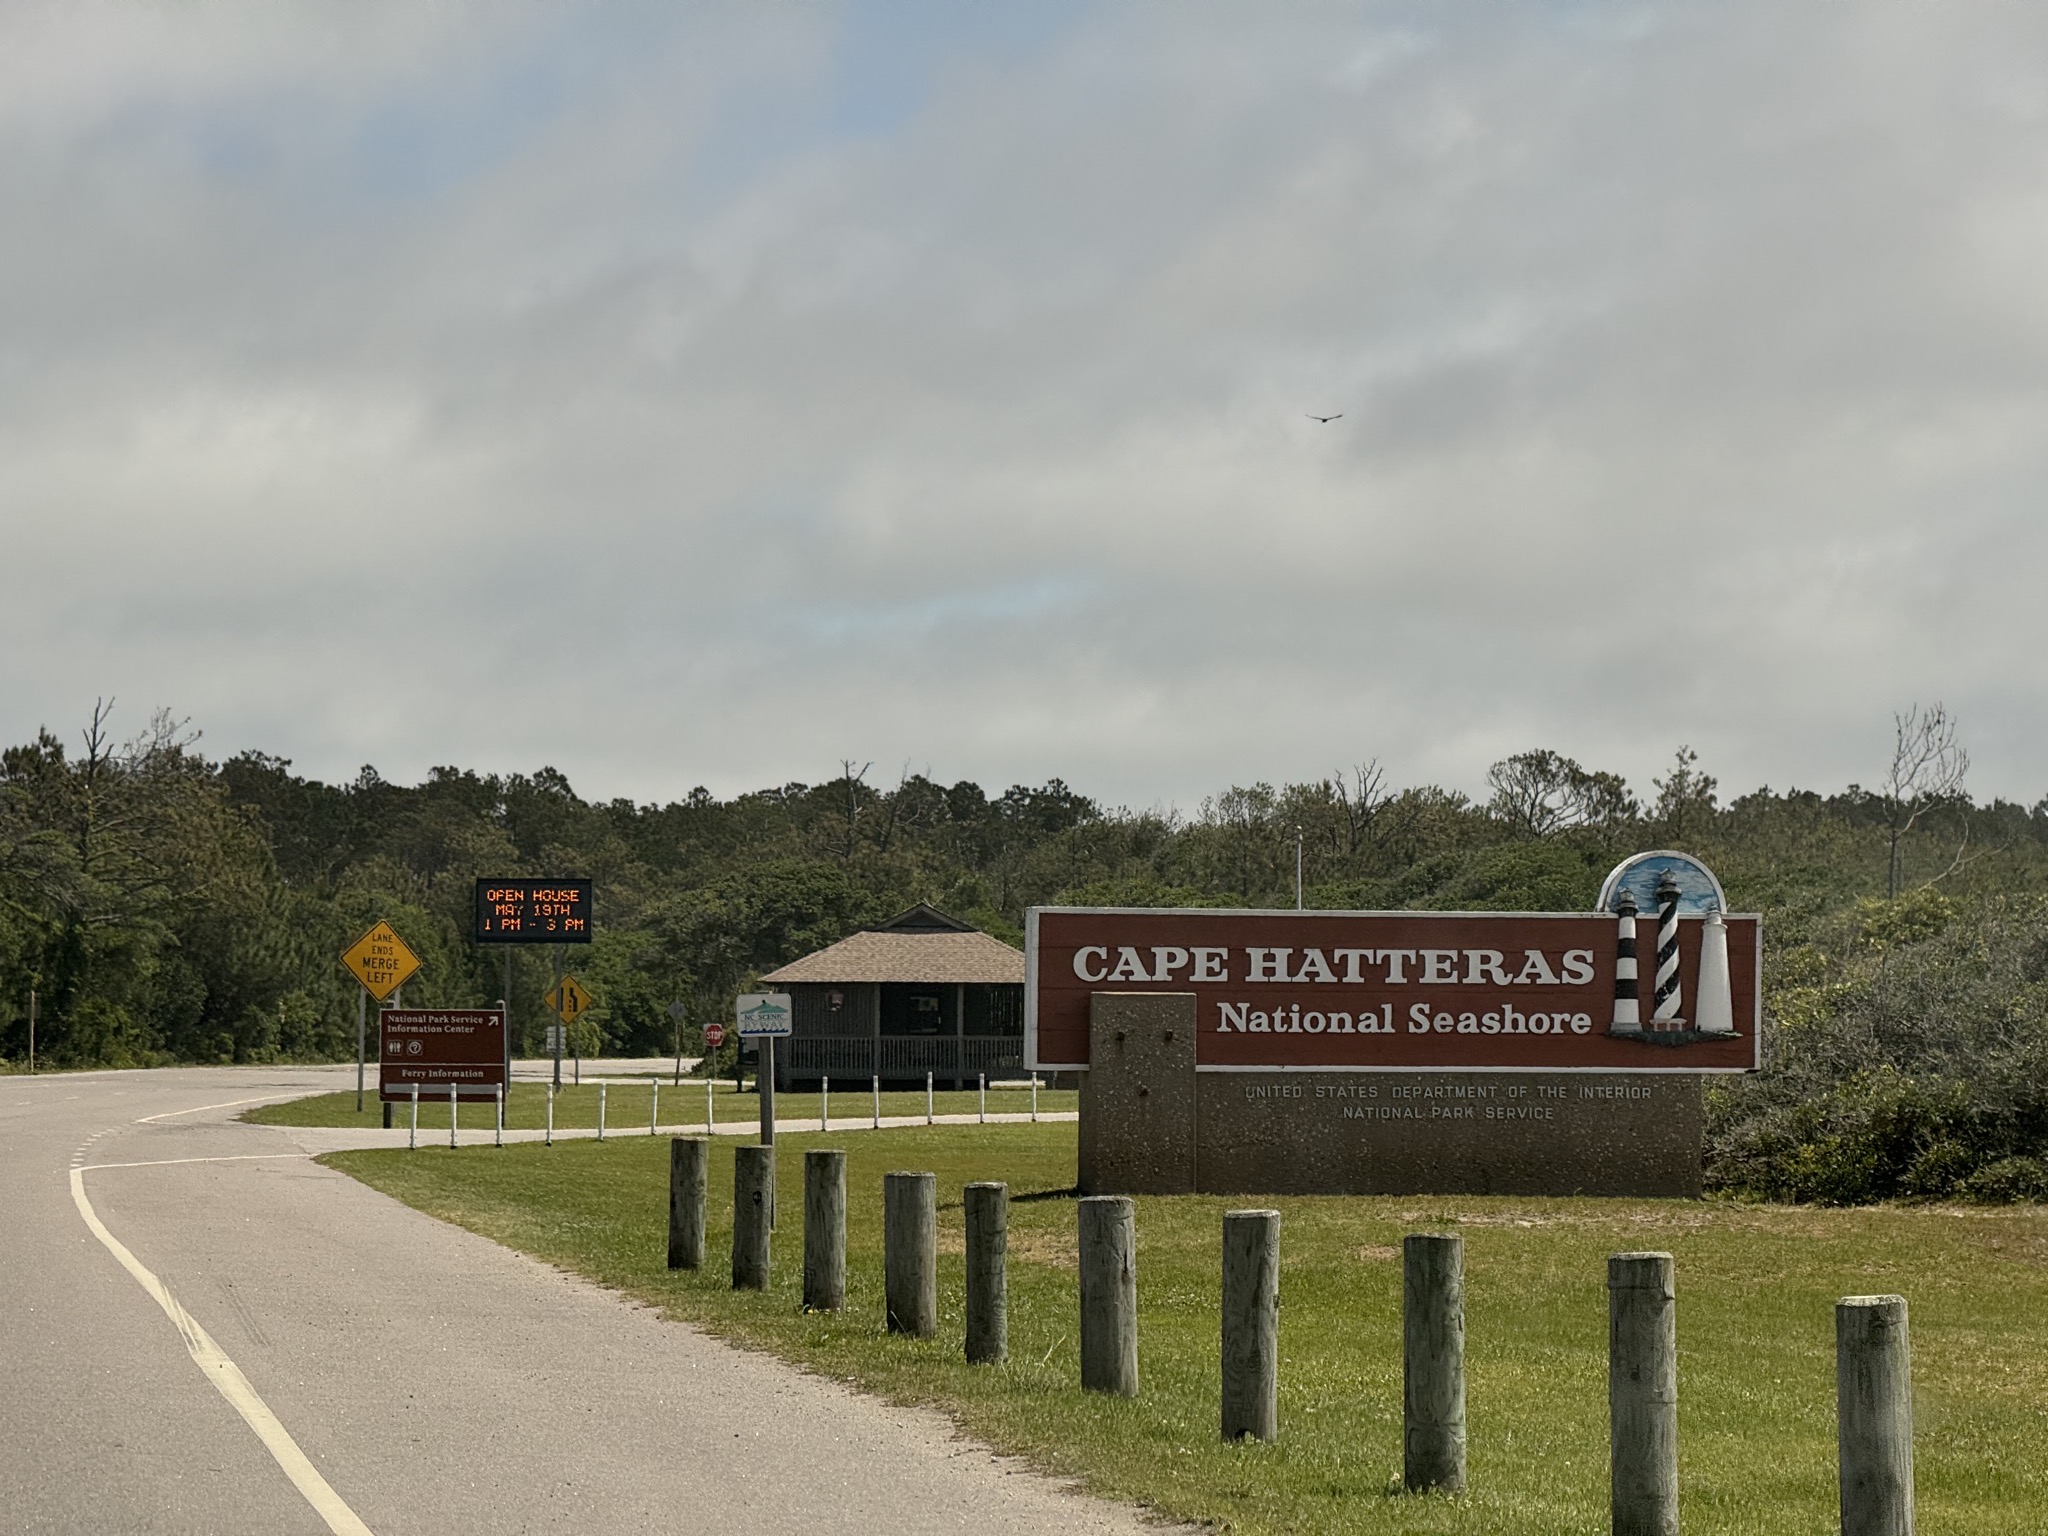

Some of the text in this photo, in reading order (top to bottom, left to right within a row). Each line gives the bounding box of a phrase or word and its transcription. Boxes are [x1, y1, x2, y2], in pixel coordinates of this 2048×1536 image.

[487, 889, 580, 901] OPEN HOUSE
[495, 904, 570, 916] MAY 19TH
[485, 919, 491, 931] 1
[501, 919, 521, 931] PM
[546, 919, 557, 931] 3
[564, 919, 584, 931] PM
[372, 933, 393, 943] LANE
[372, 945, 394, 956] ENDS
[362, 957, 400, 970] MERGE
[1072, 946, 1595, 986] CAPE HATTERAS
[367, 971, 394, 984] LEFT
[387, 1015, 484, 1024] National Park Service
[744, 1020, 784, 1029] BYWAY
[1216, 1002, 1592, 1035] National Seashore
[387, 1024, 475, 1033] Information Center
[706, 1031, 722, 1040] STOP
[401, 1069, 484, 1079] Ferry Information
[1245, 1085, 1651, 1099] UNITED STATES DEPARTMENT OF THE INTERIOR
[1343, 1106, 1554, 1119] NATIONAL PARK SERVICE
